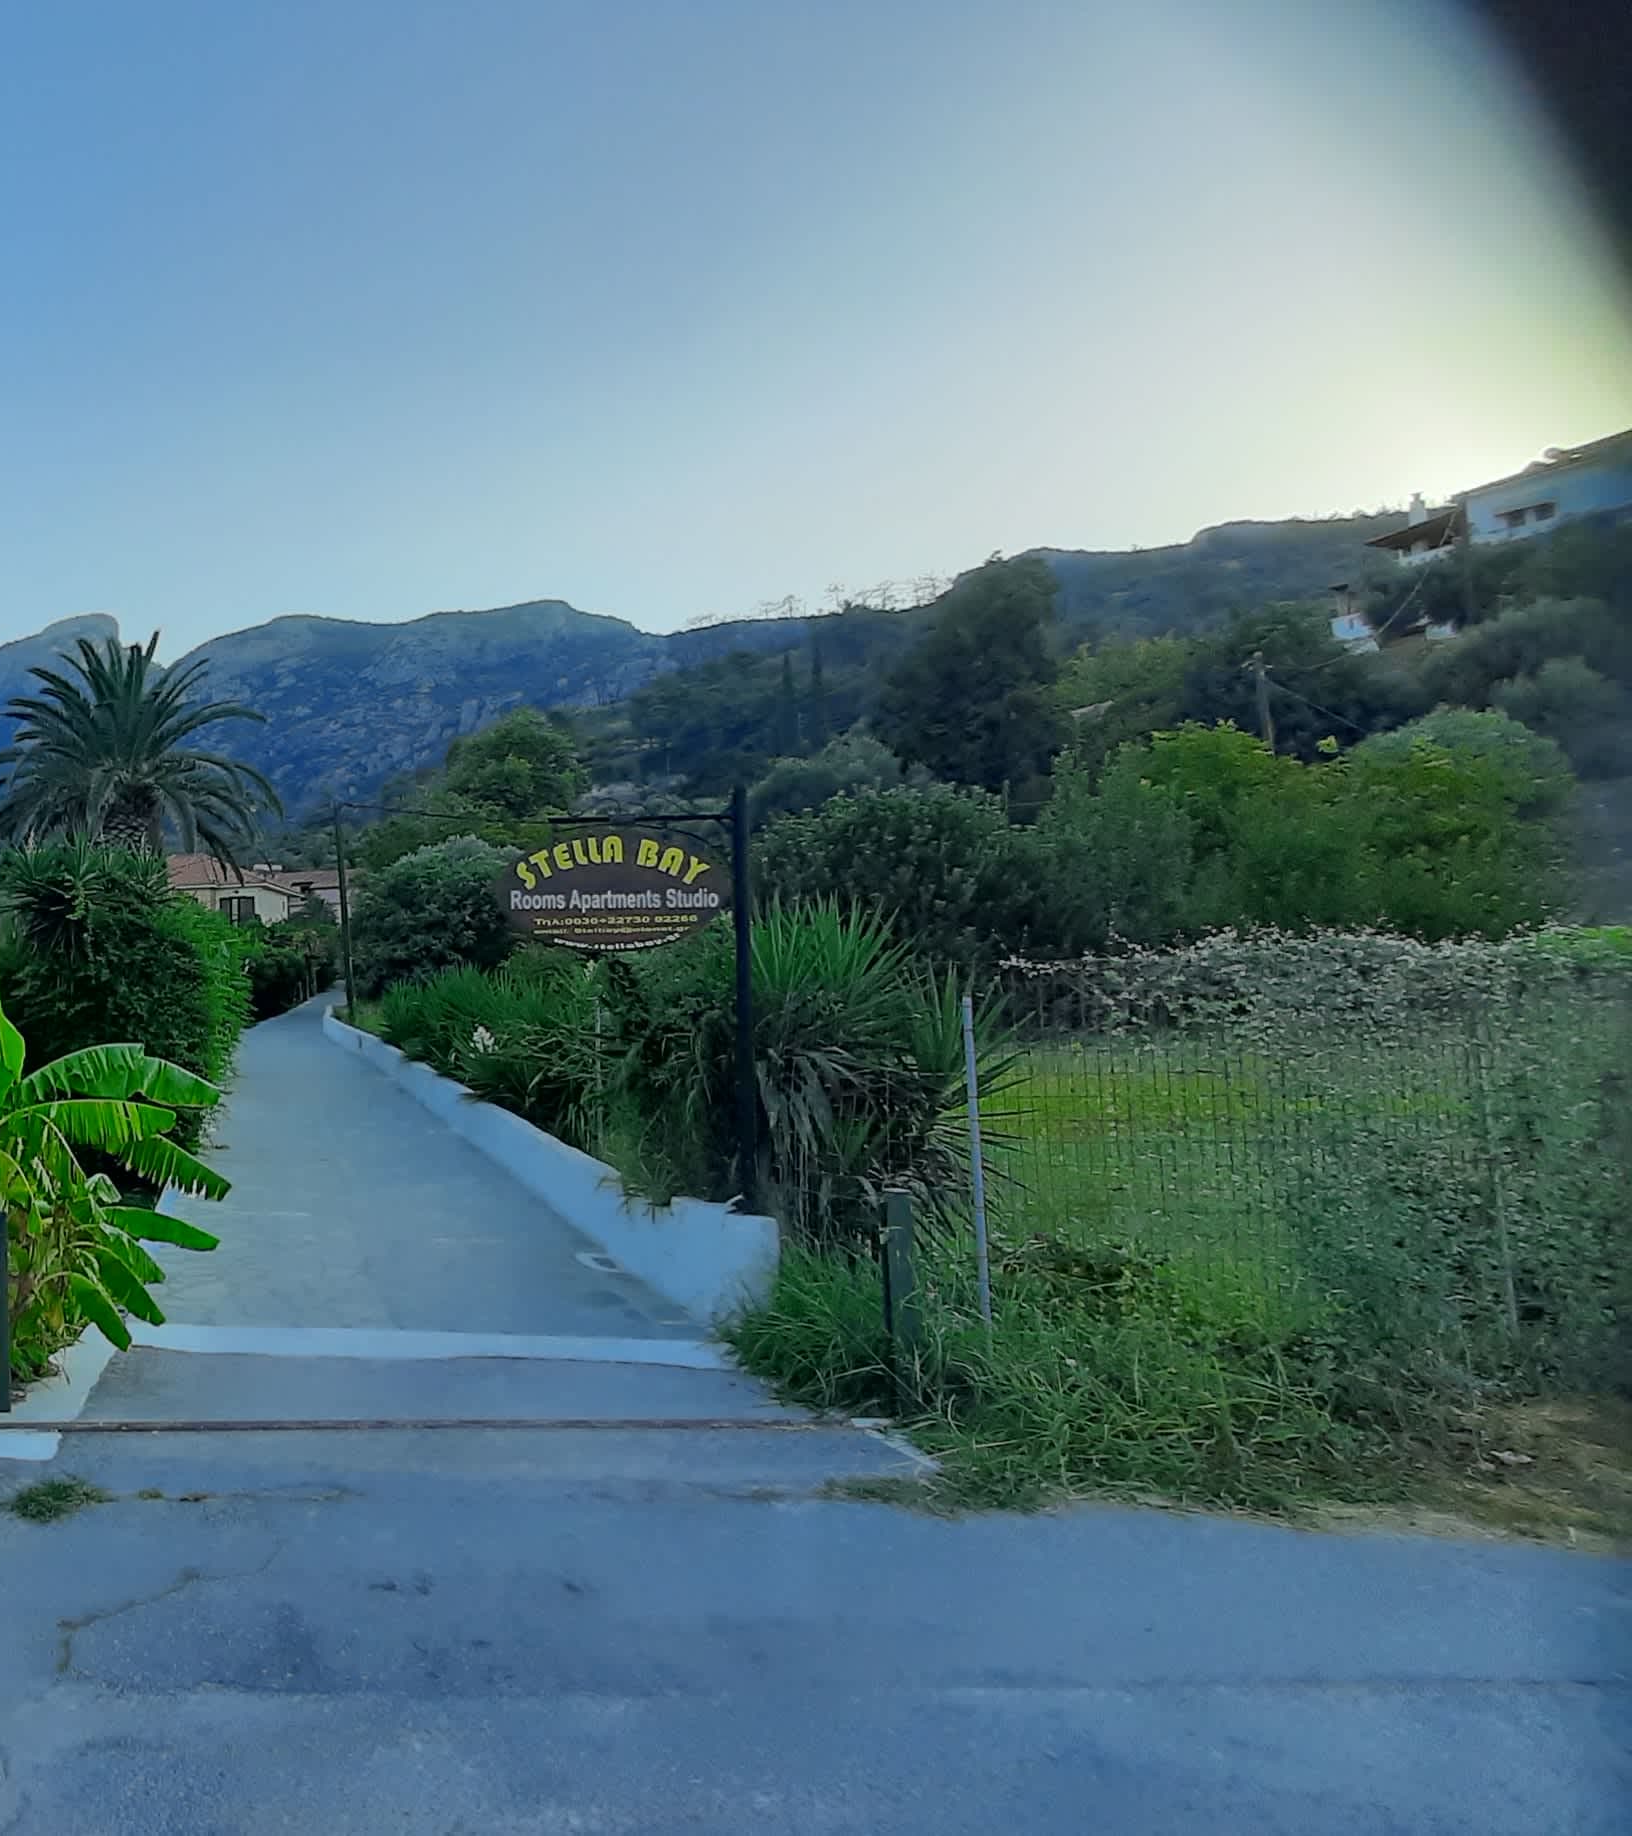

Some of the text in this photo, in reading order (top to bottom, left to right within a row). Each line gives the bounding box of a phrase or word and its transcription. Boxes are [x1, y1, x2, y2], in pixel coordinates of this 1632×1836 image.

[516, 835, 712, 890] STELLA BAY
[510, 888, 719, 913] Rooms Apartments Studio
